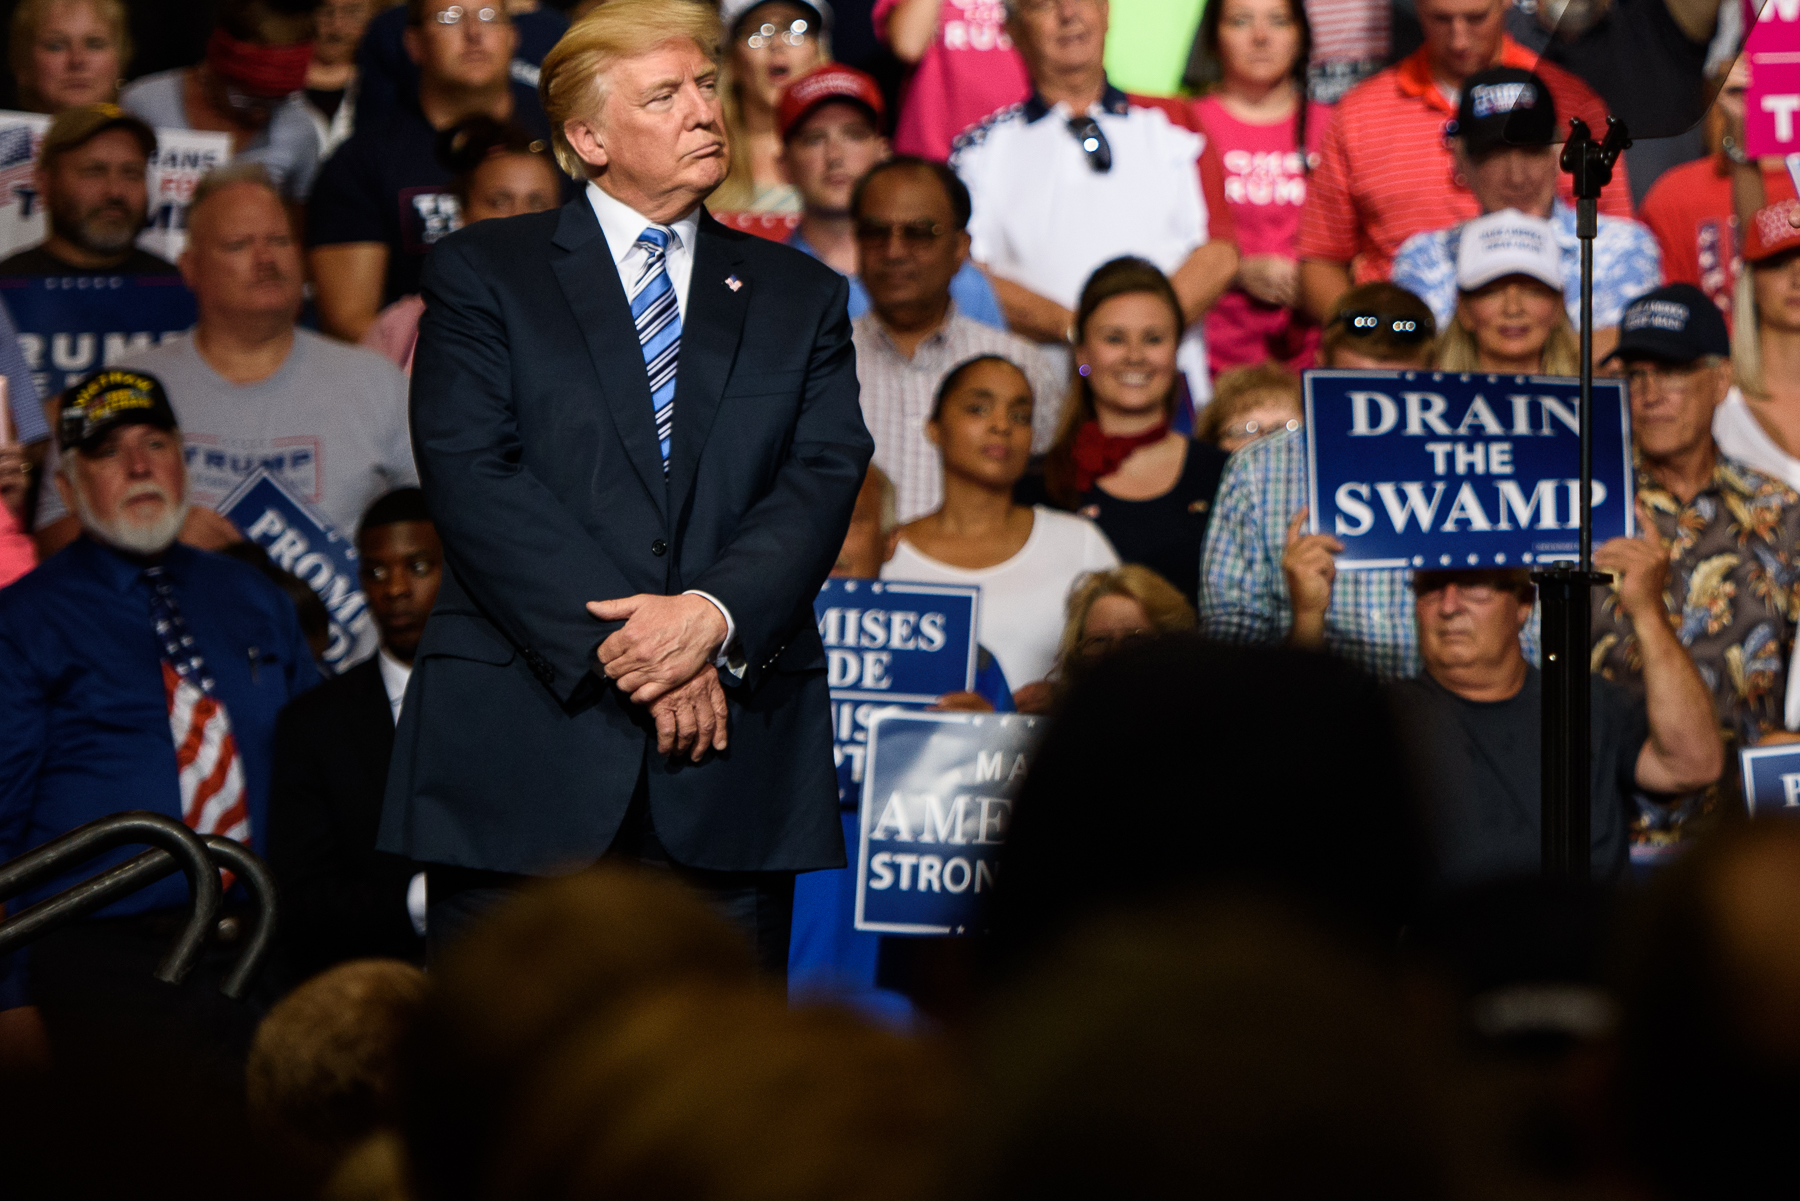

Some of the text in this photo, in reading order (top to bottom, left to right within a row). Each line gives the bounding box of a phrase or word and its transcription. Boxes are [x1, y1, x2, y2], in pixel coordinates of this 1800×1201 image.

[1345, 390, 1581, 437] DRAIN
[1425, 441, 1515, 476] THE
[1335, 478, 1608, 537] SWAMP
